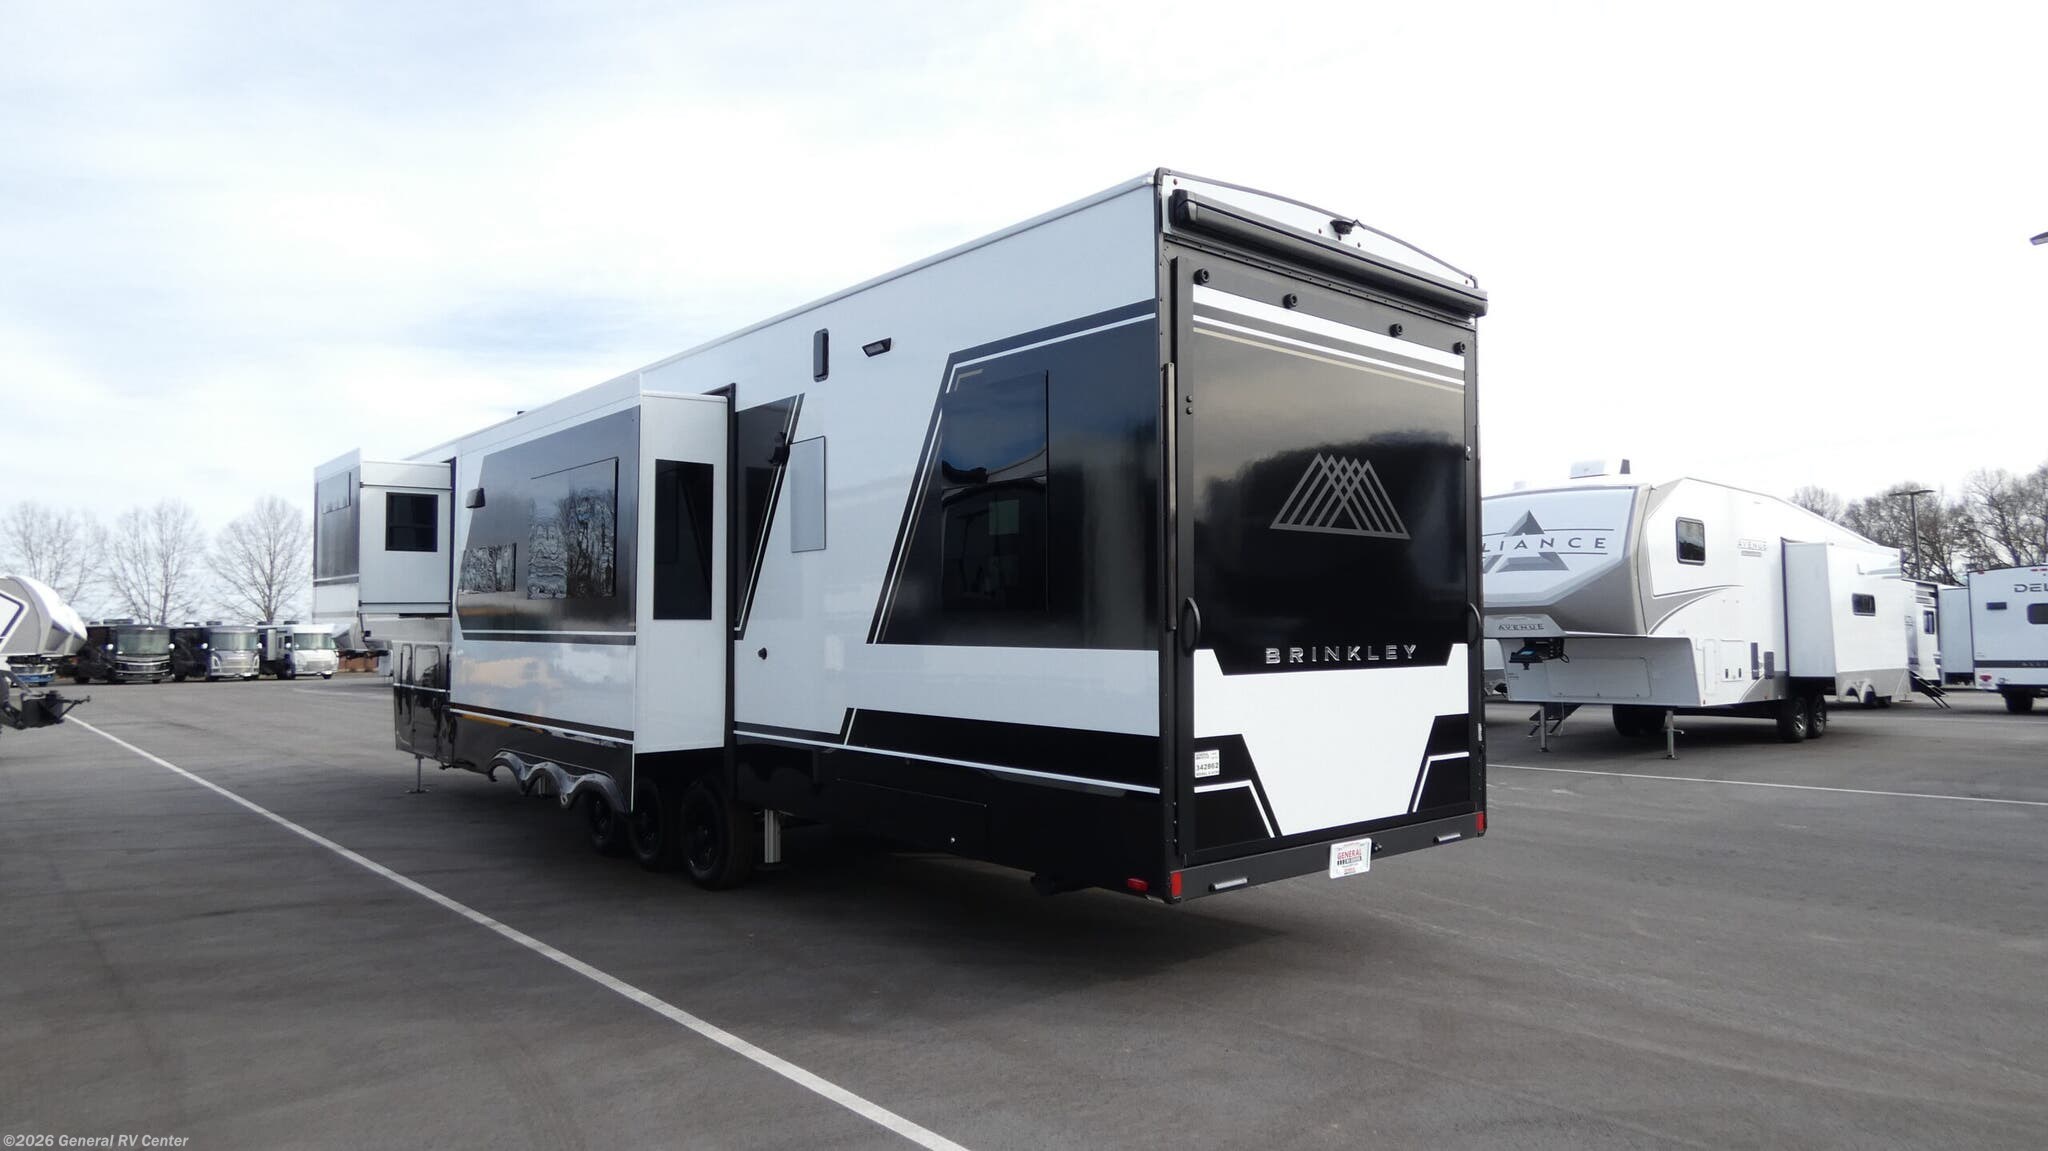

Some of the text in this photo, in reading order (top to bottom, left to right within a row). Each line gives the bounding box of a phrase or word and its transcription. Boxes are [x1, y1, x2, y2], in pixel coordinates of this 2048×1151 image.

[1498, 622, 1546, 632] AVENUE
[1265, 644, 1417, 664] BRINKLEY
[1337, 848, 1362, 860] GENERAL
